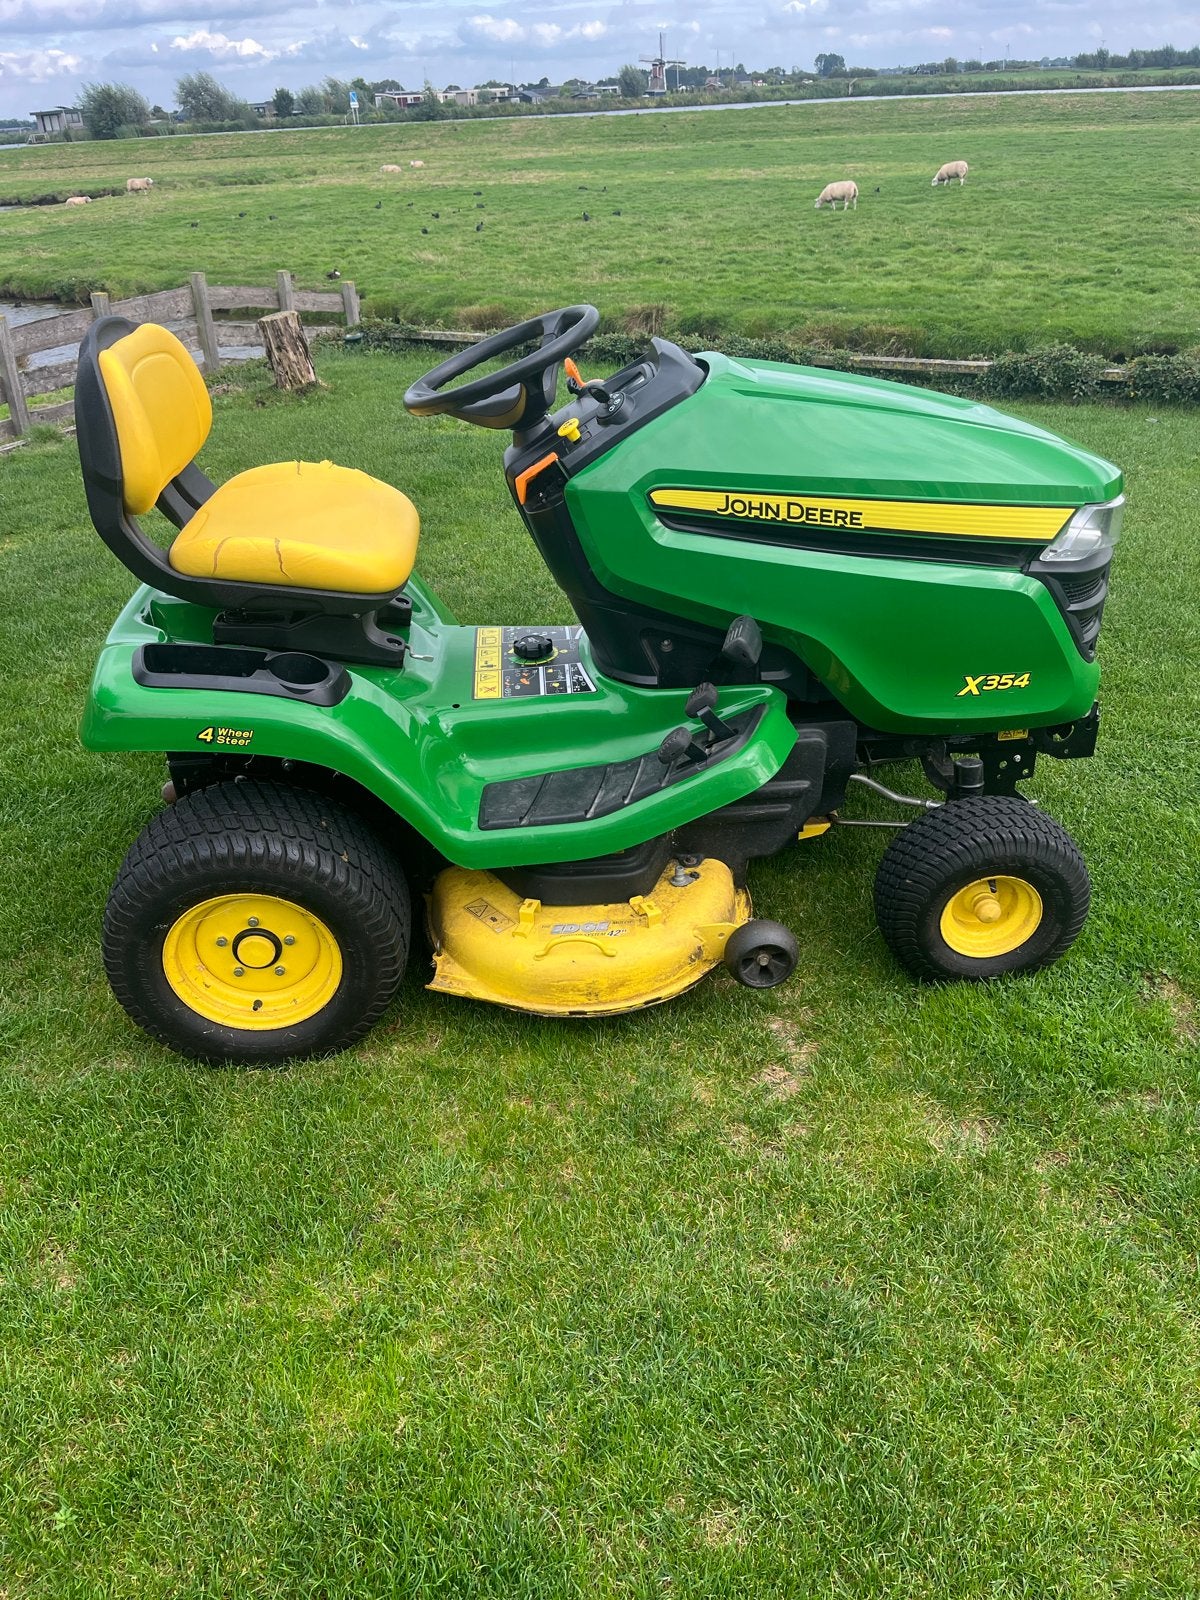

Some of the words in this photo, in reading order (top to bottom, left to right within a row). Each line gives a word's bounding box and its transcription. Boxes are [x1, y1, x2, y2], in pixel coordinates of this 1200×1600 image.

[716, 495, 780, 518] JOHN
[786, 502, 863, 527] DEERE
[956, 672, 1032, 697] X354
[197, 726, 215, 743] 4
[217, 727, 254, 738] Wheel
[216, 735, 251, 746] Steer
